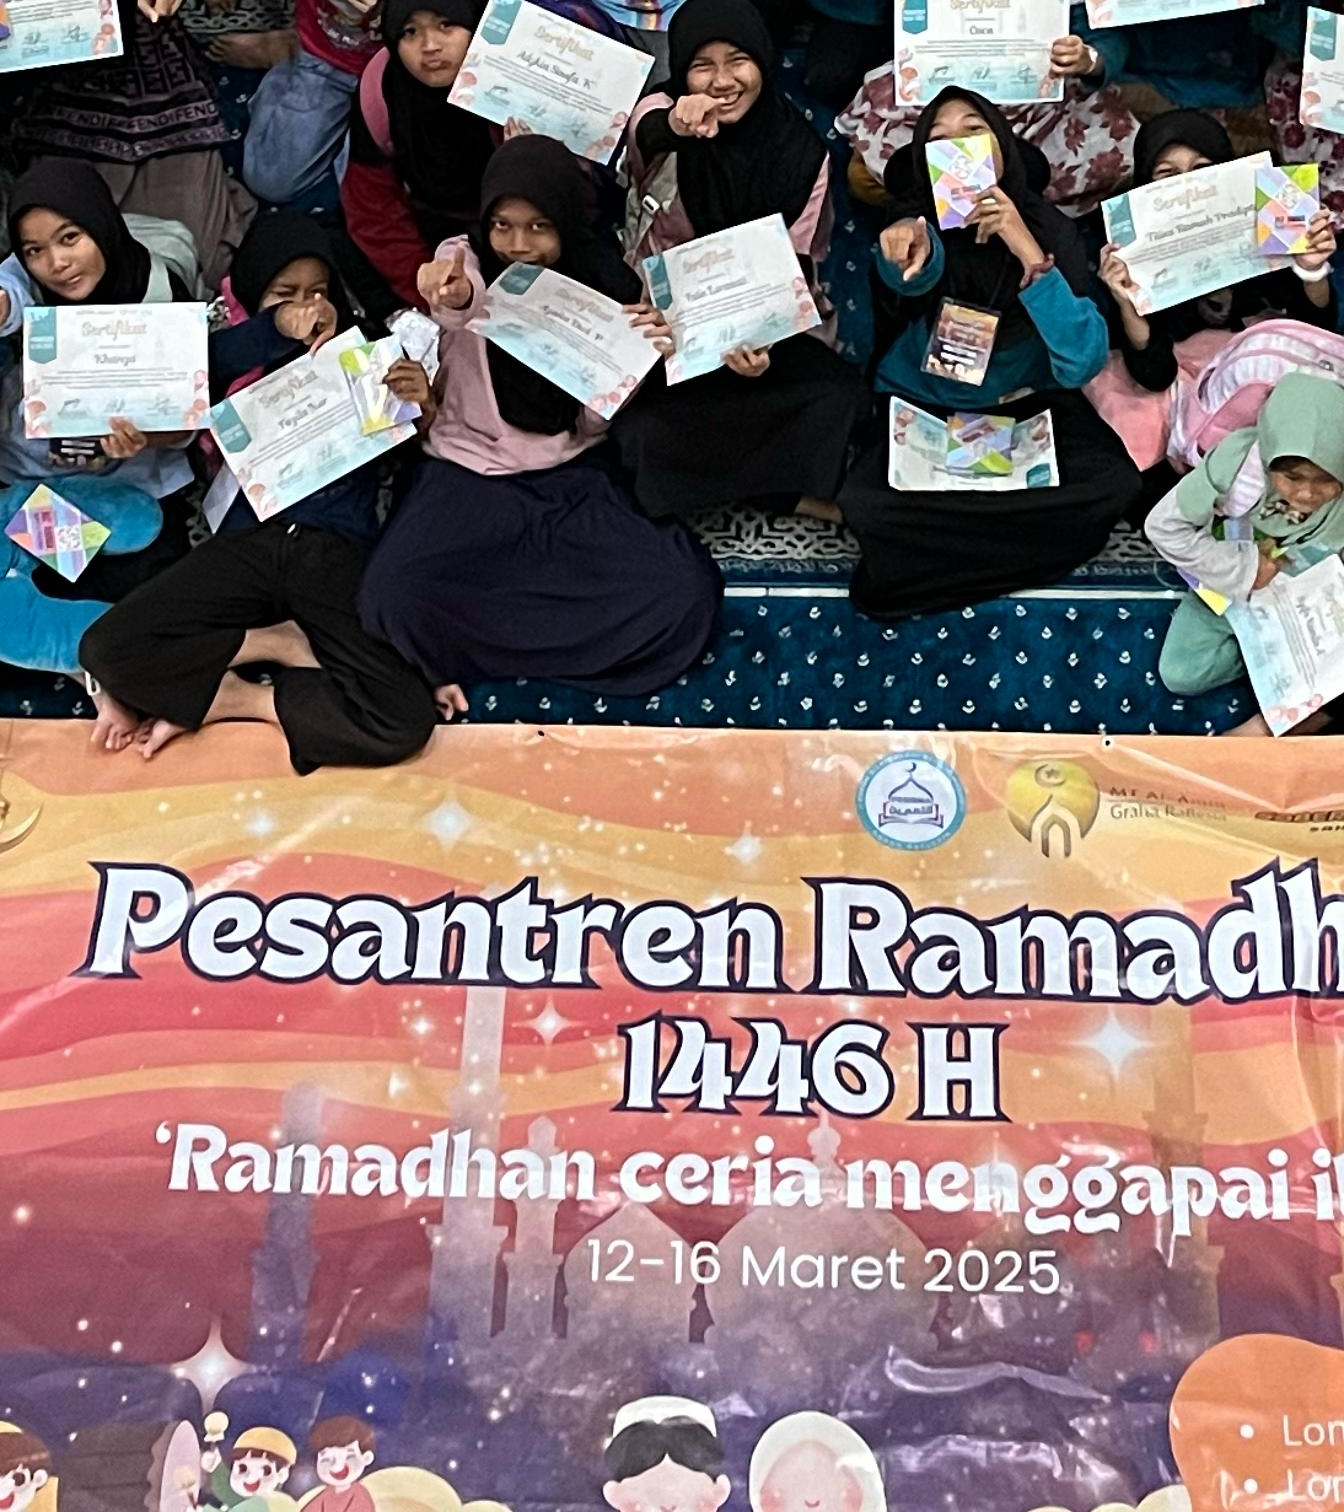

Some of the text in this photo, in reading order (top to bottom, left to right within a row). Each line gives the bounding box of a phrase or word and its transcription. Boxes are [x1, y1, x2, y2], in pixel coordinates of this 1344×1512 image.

[535, 26, 594, 61] Sertifikat
[1153, 186, 1217, 211] Sertifikat
[81, 320, 148, 340] Sertifikat
[77, 861, 782, 990] Pesantren
[613, 1009, 1012, 1124] 1446 H
[620, 1136, 821, 1210] ceria
[844, 1143, 1291, 1238] menggapai
[740, 1244, 905, 1291] Maret
[924, 1248, 1061, 1296] 2025
